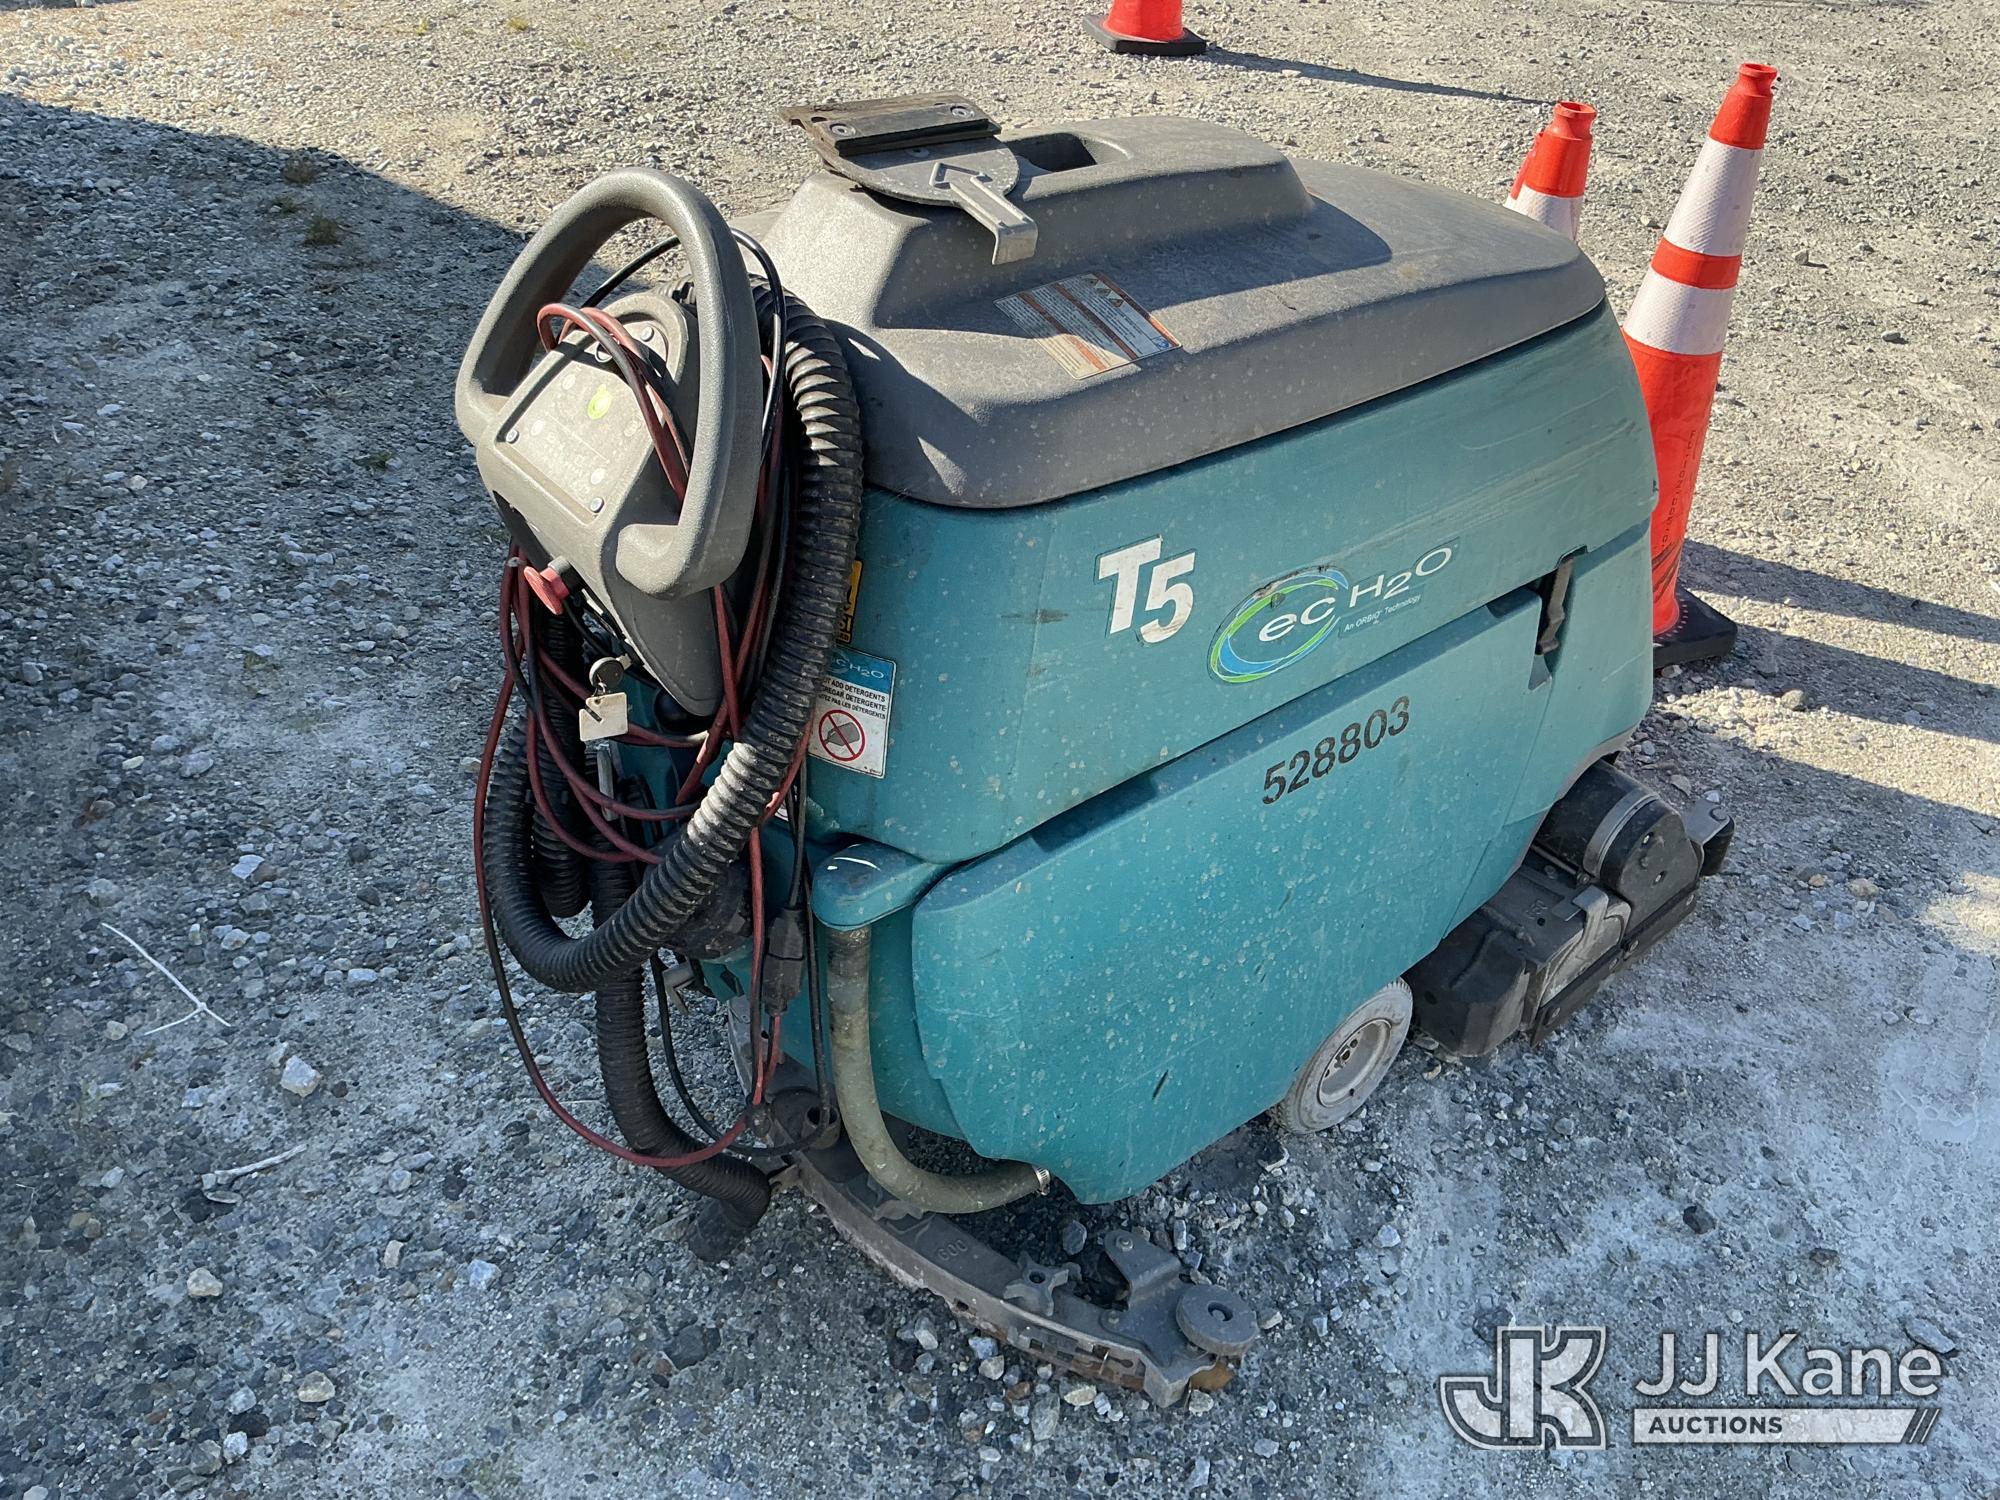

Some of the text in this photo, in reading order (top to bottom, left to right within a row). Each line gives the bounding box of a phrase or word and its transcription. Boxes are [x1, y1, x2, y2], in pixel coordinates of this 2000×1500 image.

[1097, 537, 1196, 643] T5
[831, 680, 844, 689] ADD
[845, 685, 886, 702] DETERGENTS
[1262, 695, 1411, 805] 528803
